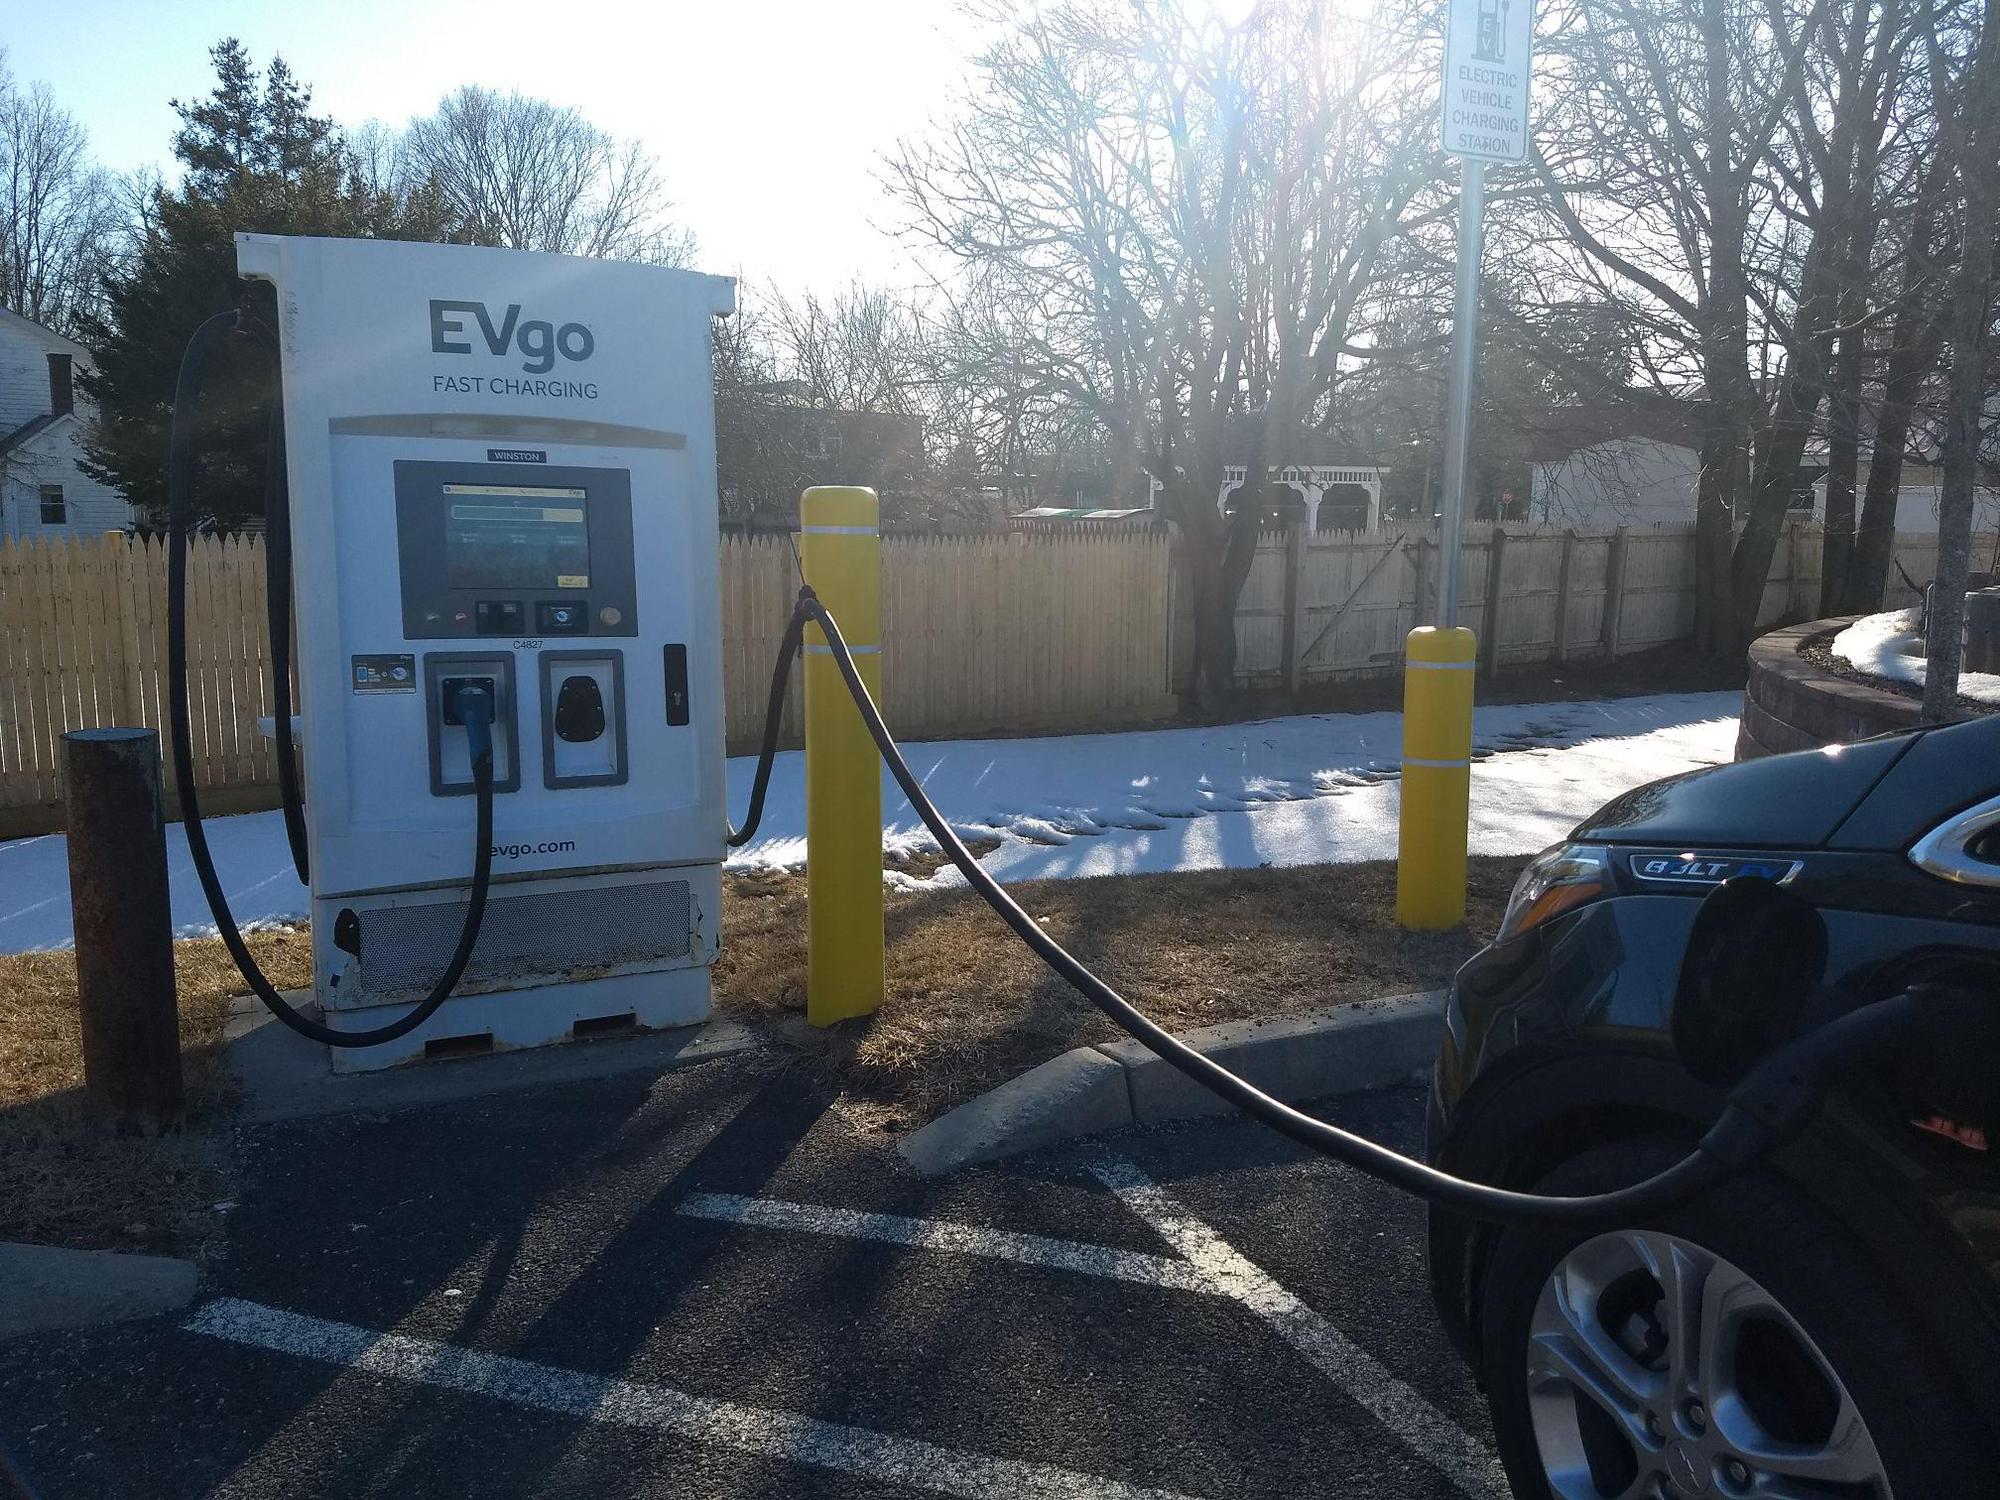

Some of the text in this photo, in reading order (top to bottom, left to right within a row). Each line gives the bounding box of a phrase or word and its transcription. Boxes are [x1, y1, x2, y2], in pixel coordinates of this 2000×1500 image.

[1458, 64, 1518, 89] ELECTRIC
[1461, 88, 1513, 110] VEHICLE
[1452, 109, 1519, 133] CHARGING
[1458, 133, 1511, 153] STATION
[429, 299, 595, 374] EVgo
[433, 375, 599, 399] FAST CHARGING
[494, 451, 540, 462] WINSTON
[513, 640, 544, 650] C4827
[489, 840, 575, 859] evgo.com
